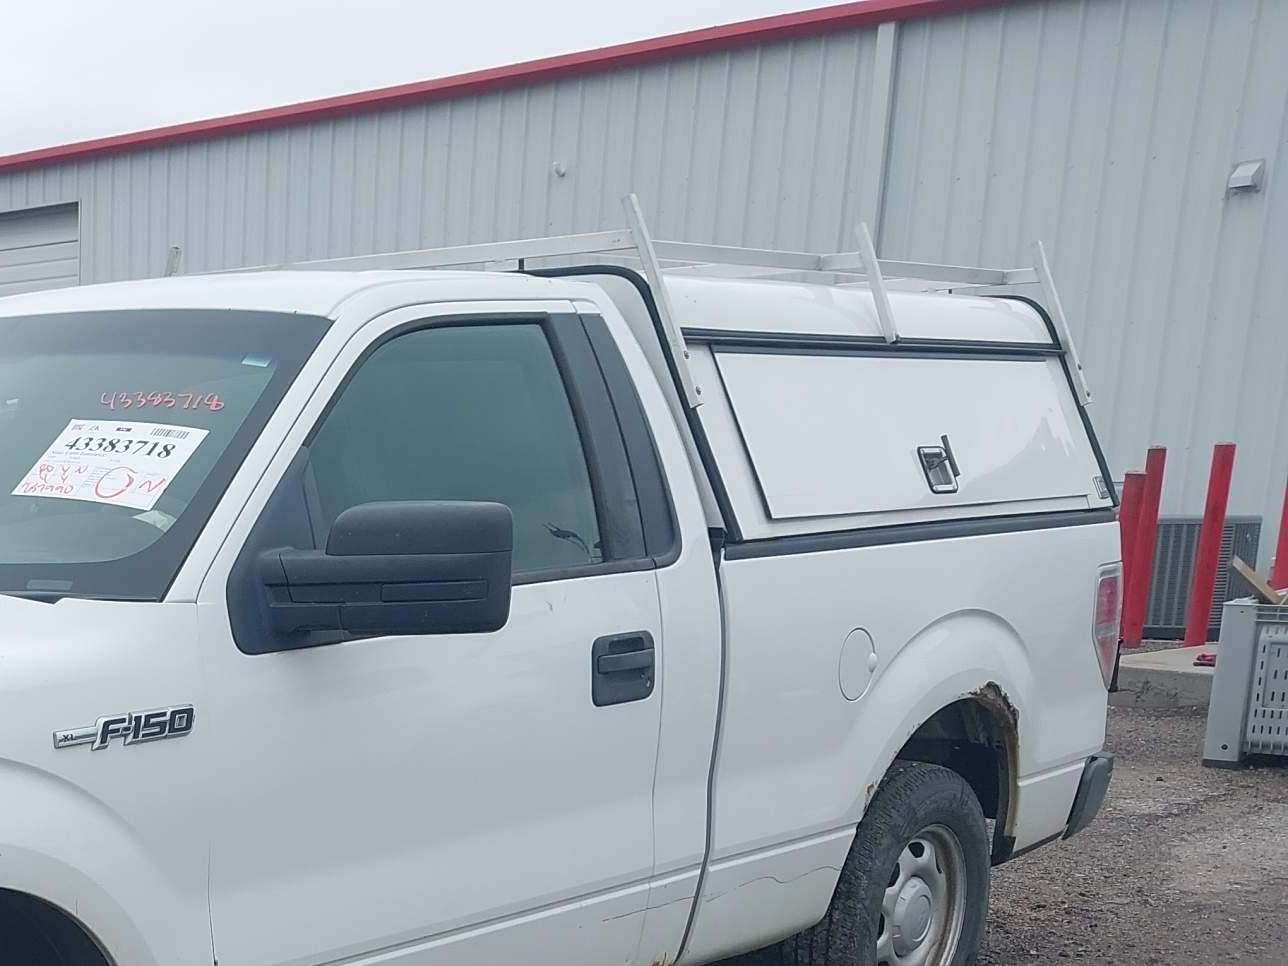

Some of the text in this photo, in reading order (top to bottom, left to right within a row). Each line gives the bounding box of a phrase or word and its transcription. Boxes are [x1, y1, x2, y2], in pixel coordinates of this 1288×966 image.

[100, 391, 225, 410] 43383718
[64, 436, 176, 459] 43383718
[96, 706, 195, 747] F-150
